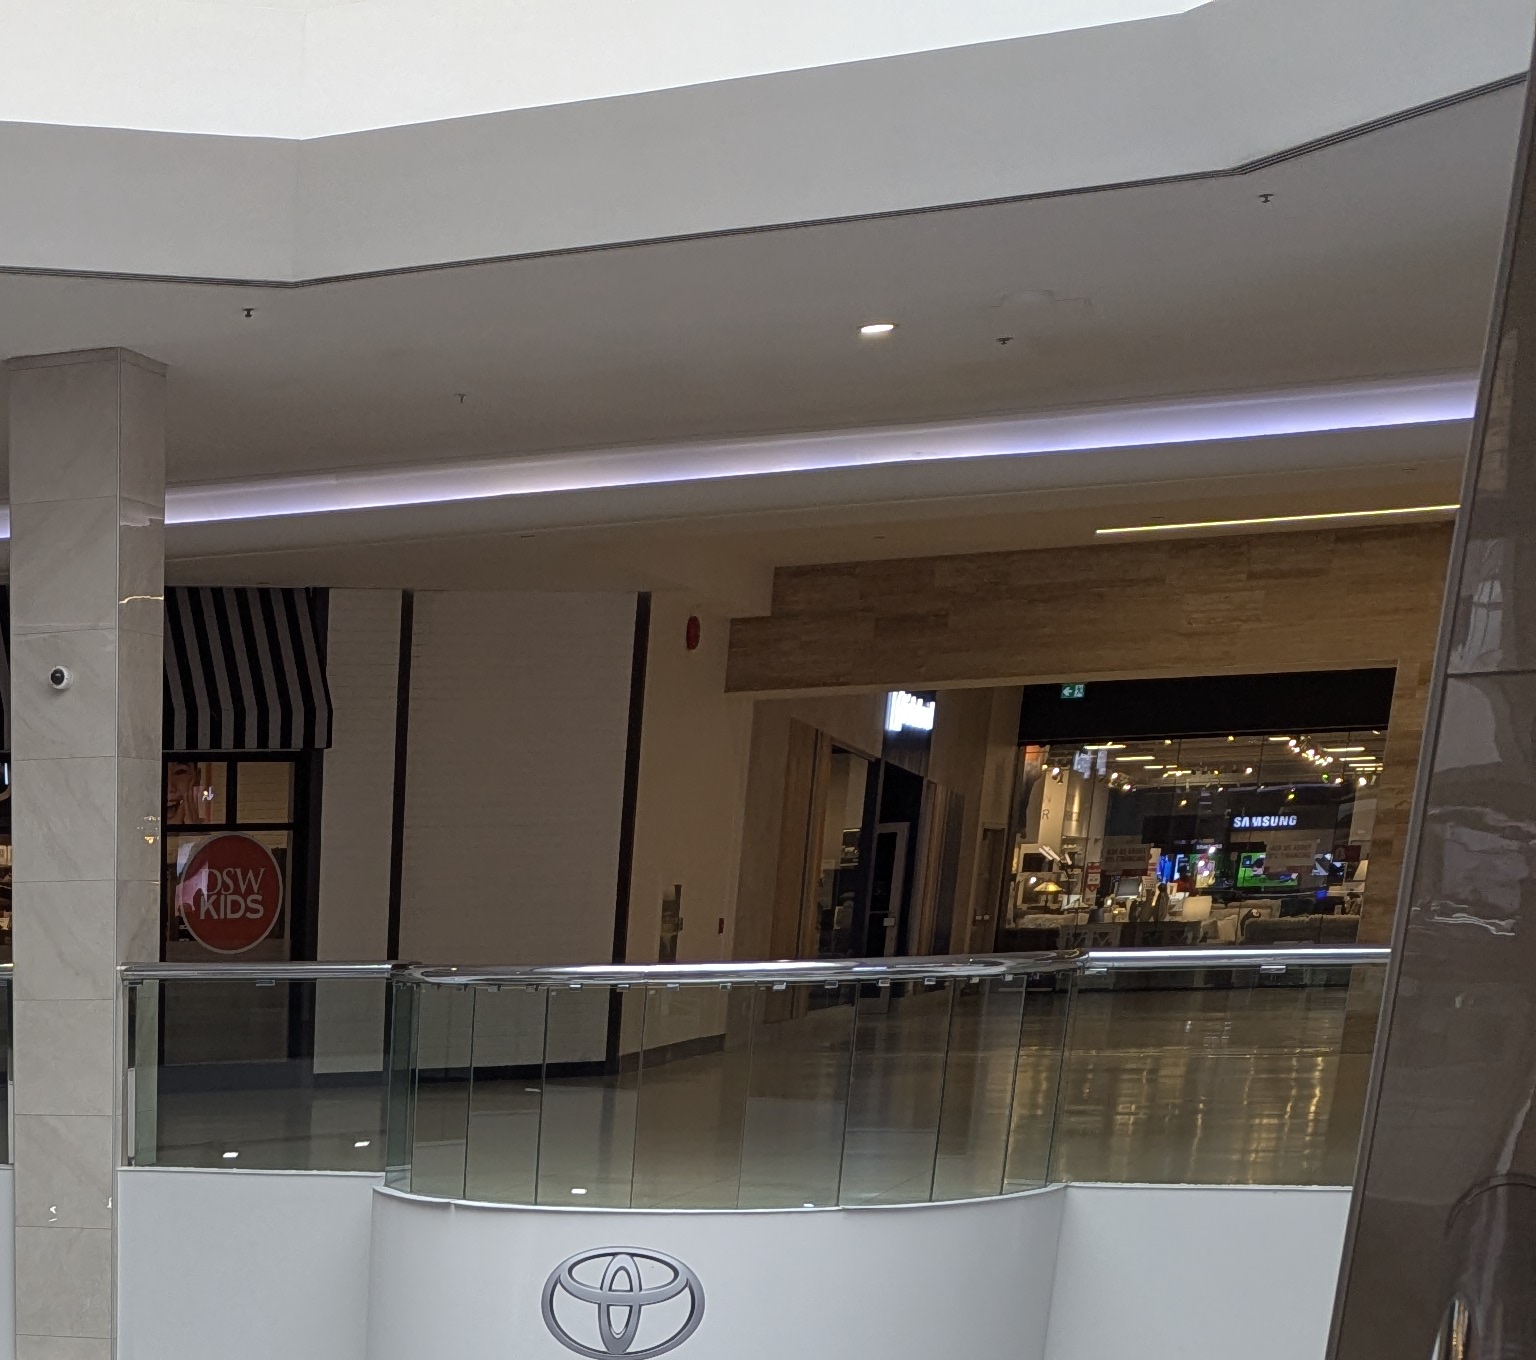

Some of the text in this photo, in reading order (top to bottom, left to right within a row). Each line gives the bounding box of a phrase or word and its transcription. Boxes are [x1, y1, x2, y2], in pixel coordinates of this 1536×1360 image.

[1233, 815, 1297, 828] SAMSUNG
[201, 867, 265, 895] DSW
[199, 894, 264, 919] KIDS
